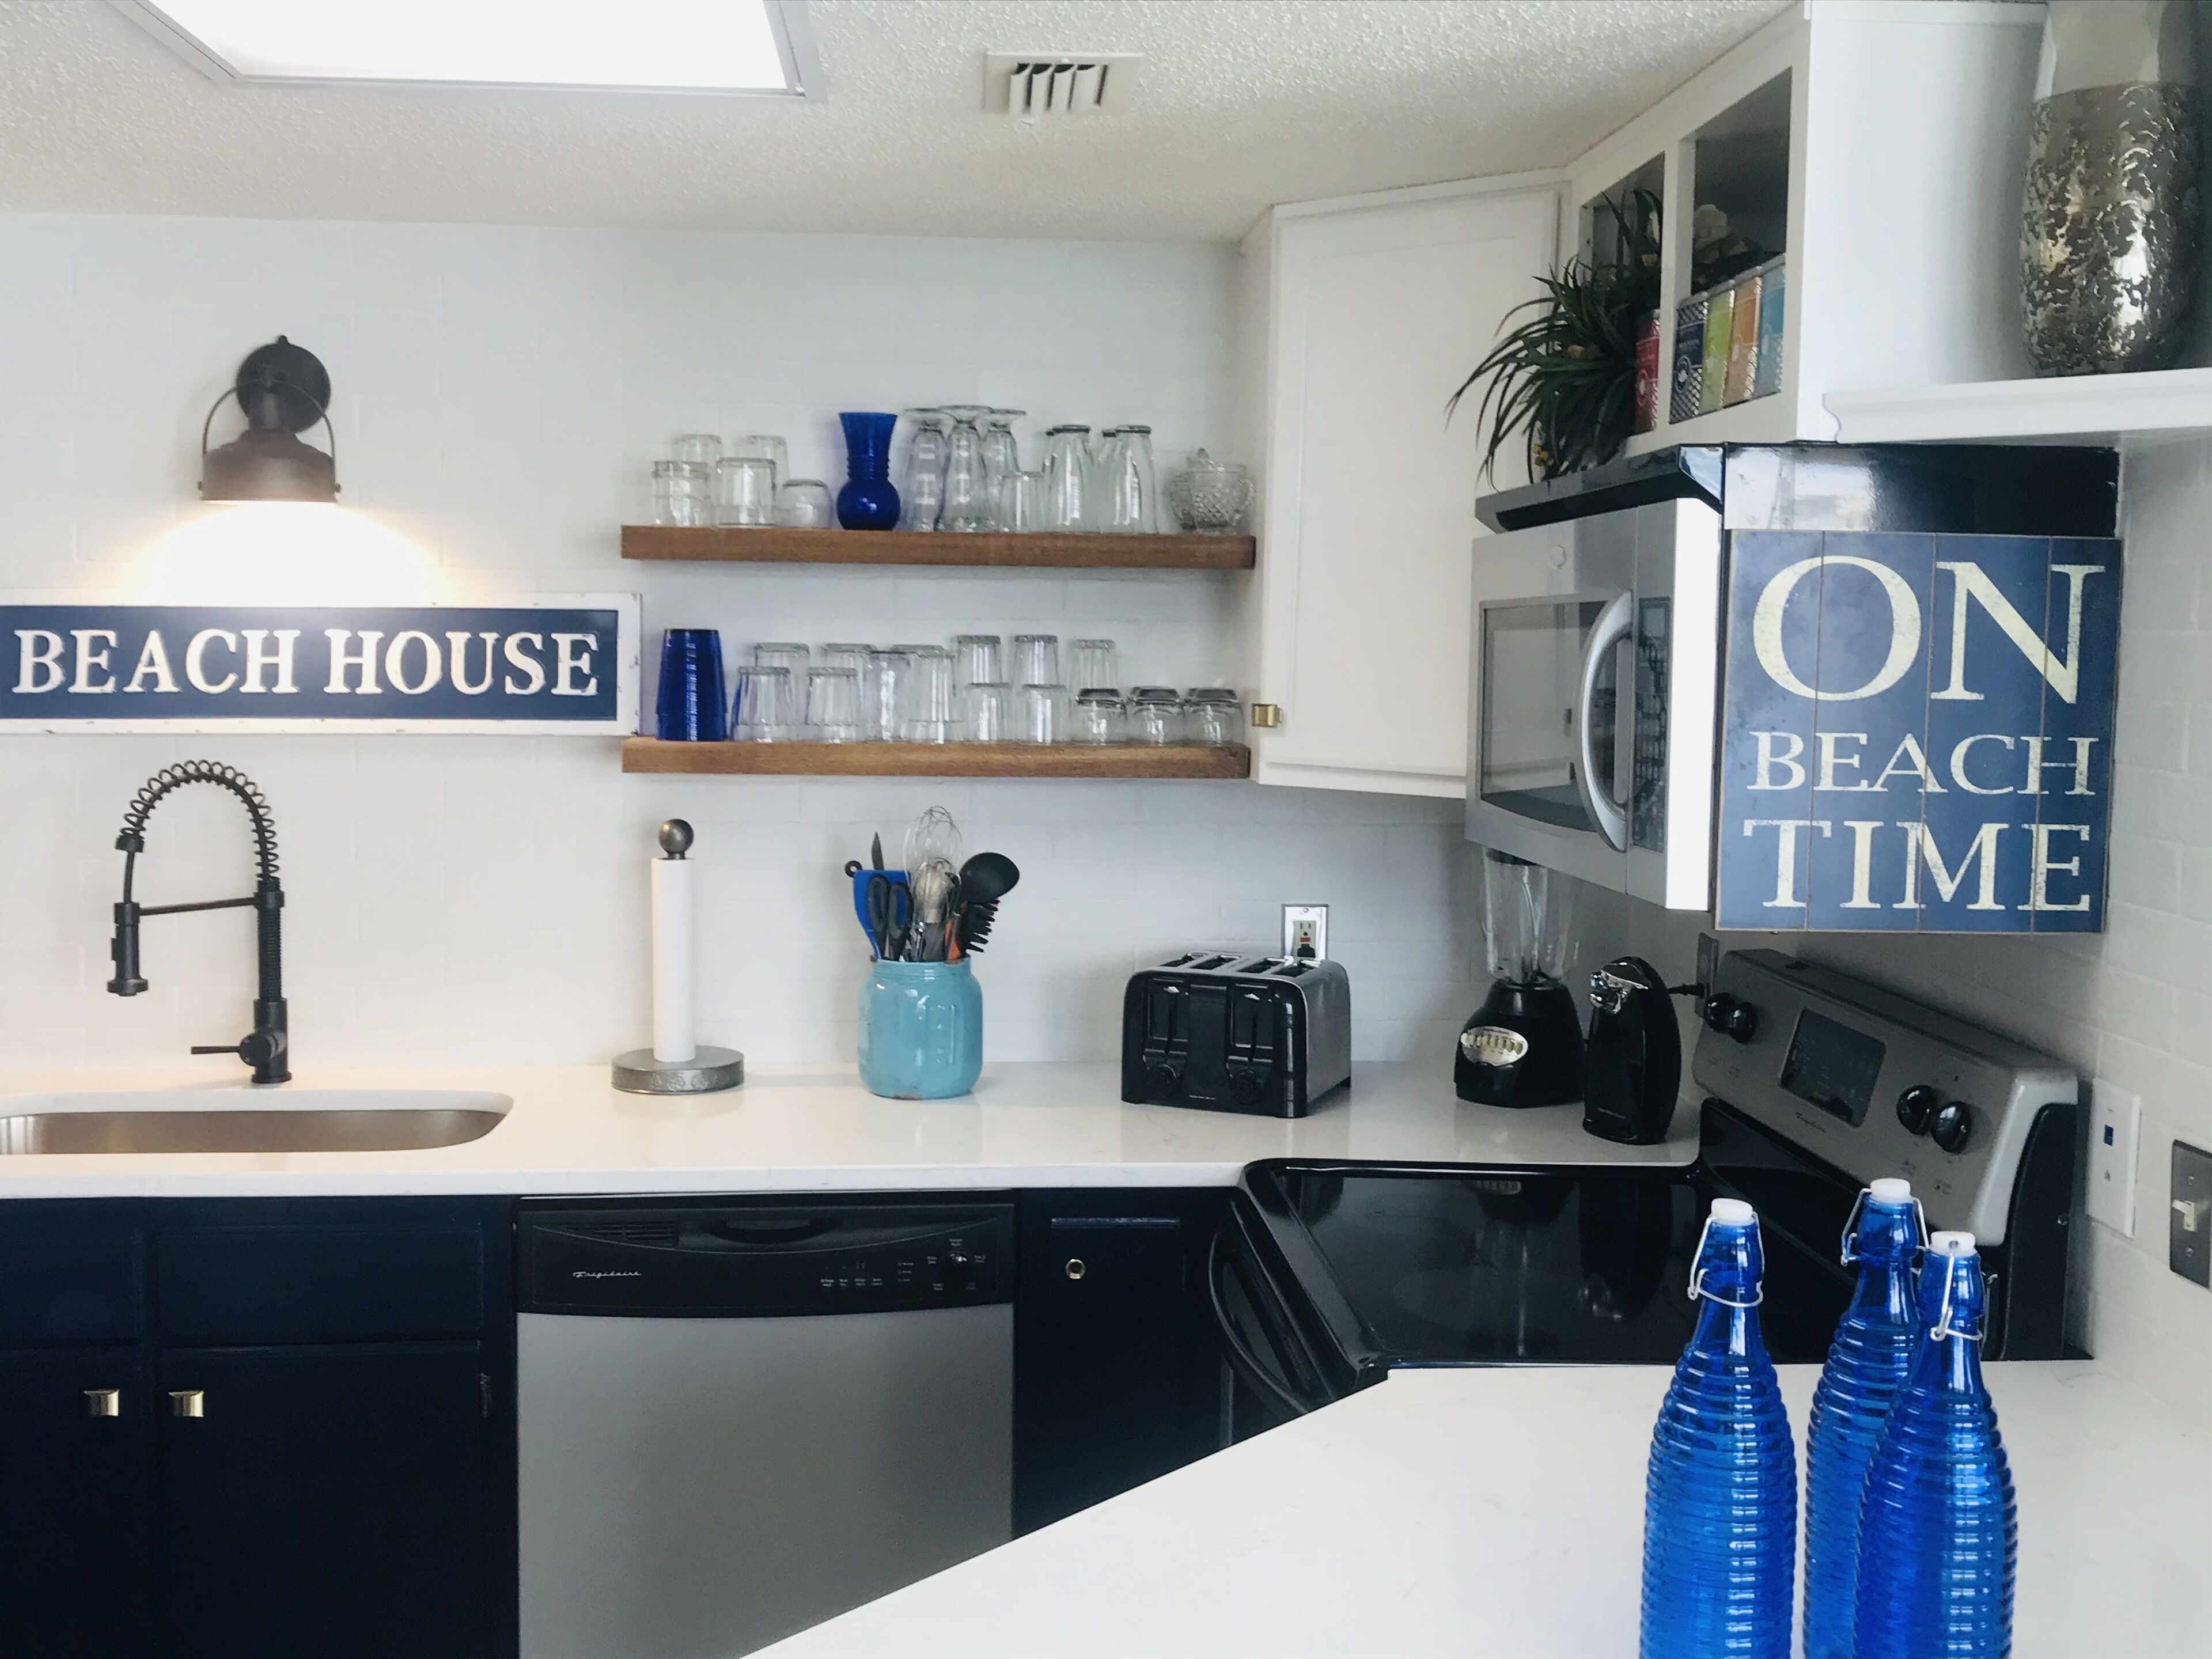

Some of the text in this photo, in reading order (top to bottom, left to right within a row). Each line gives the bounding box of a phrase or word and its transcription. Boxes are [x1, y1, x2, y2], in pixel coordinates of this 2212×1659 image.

[12, 629, 599, 695] BEACH HOUSE
[1753, 555, 2106, 704] ON
[1747, 731, 2100, 795] BEACH
[1743, 819, 2090, 911] TIME
